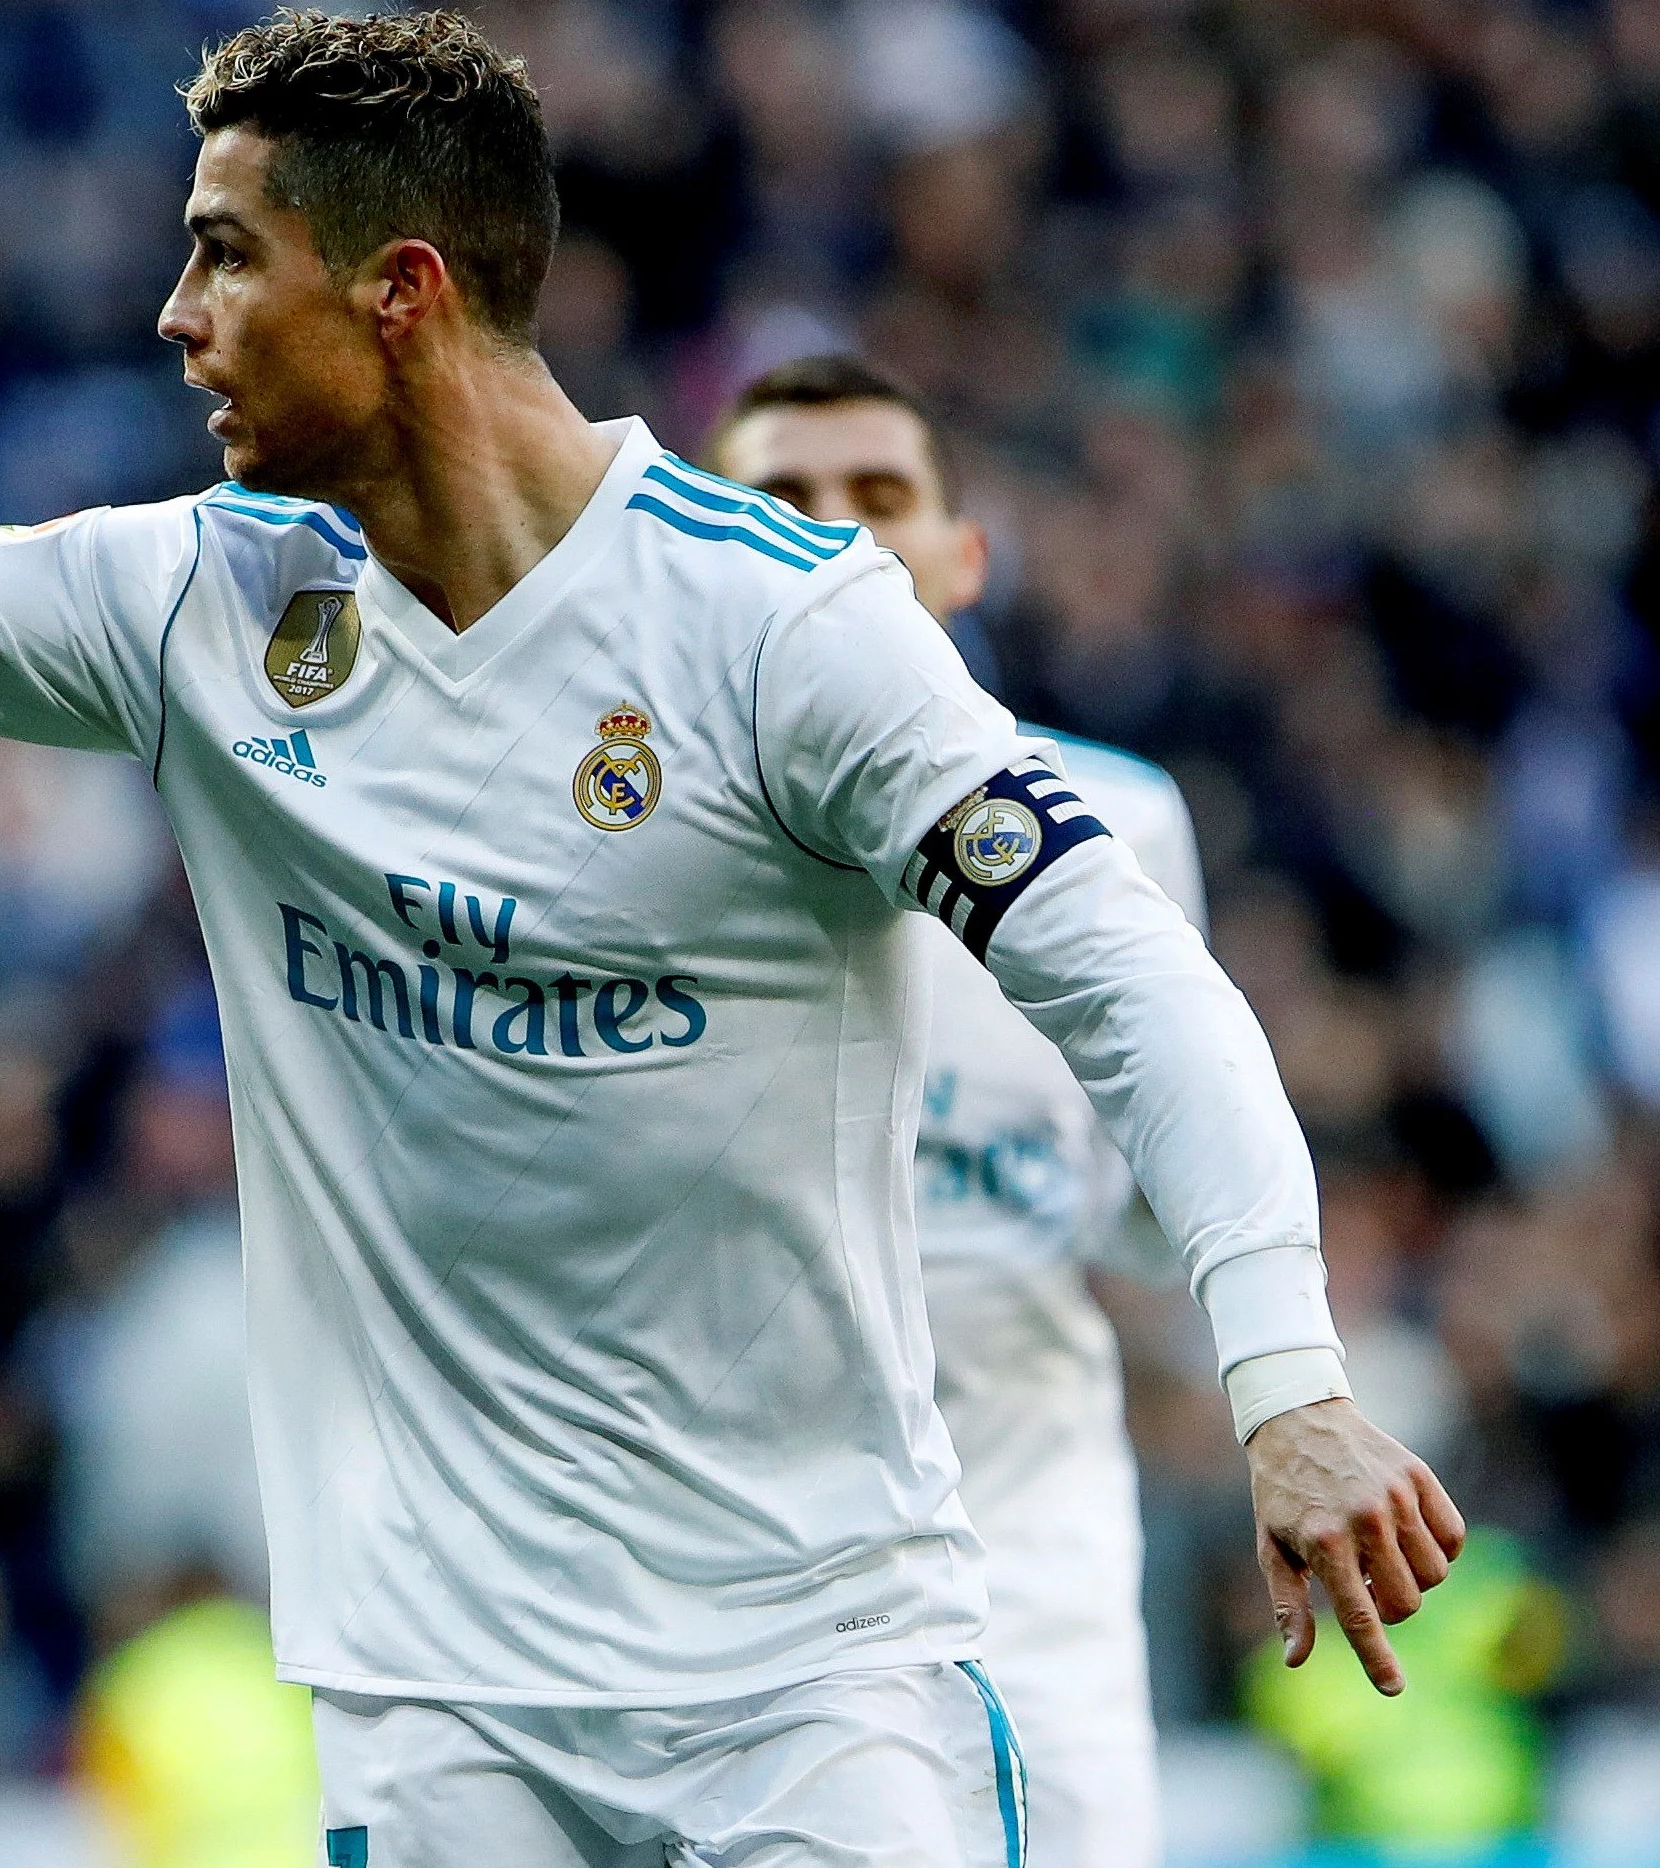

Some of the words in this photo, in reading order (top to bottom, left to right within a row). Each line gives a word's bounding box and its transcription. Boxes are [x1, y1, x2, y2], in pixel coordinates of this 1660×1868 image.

[286, 661, 328, 682] FIFA
[288, 684, 315, 696] 2017
[232, 741, 327, 788] adidas
[384, 873, 518, 964] Fly
[277, 902, 708, 1057] Emirates
[836, 1615, 891, 1633] adizero
